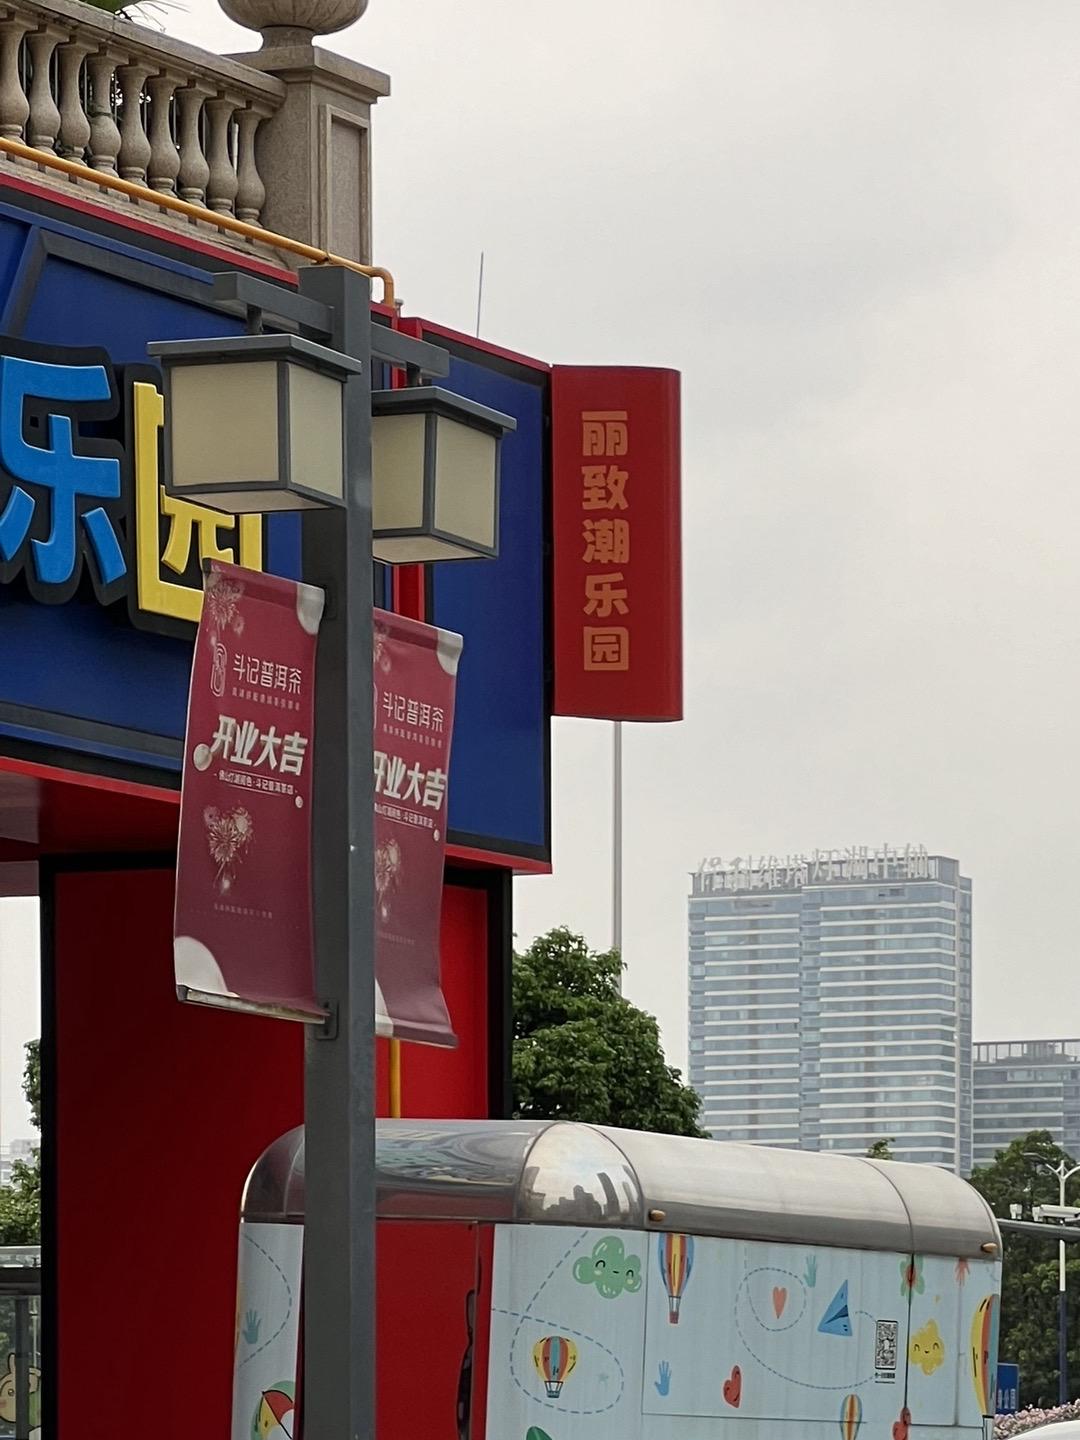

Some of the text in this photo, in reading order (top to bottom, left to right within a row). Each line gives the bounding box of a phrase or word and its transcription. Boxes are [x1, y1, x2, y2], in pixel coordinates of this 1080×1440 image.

[581, 410, 630, 671] 丽致潮乐园
[232, 653, 302, 695] 斗记普洱茶
[382, 691, 444, 733] 斗记普洱茶
[210, 714, 308, 776] 开业大吉
[373, 750, 447, 811] 开业大吉
